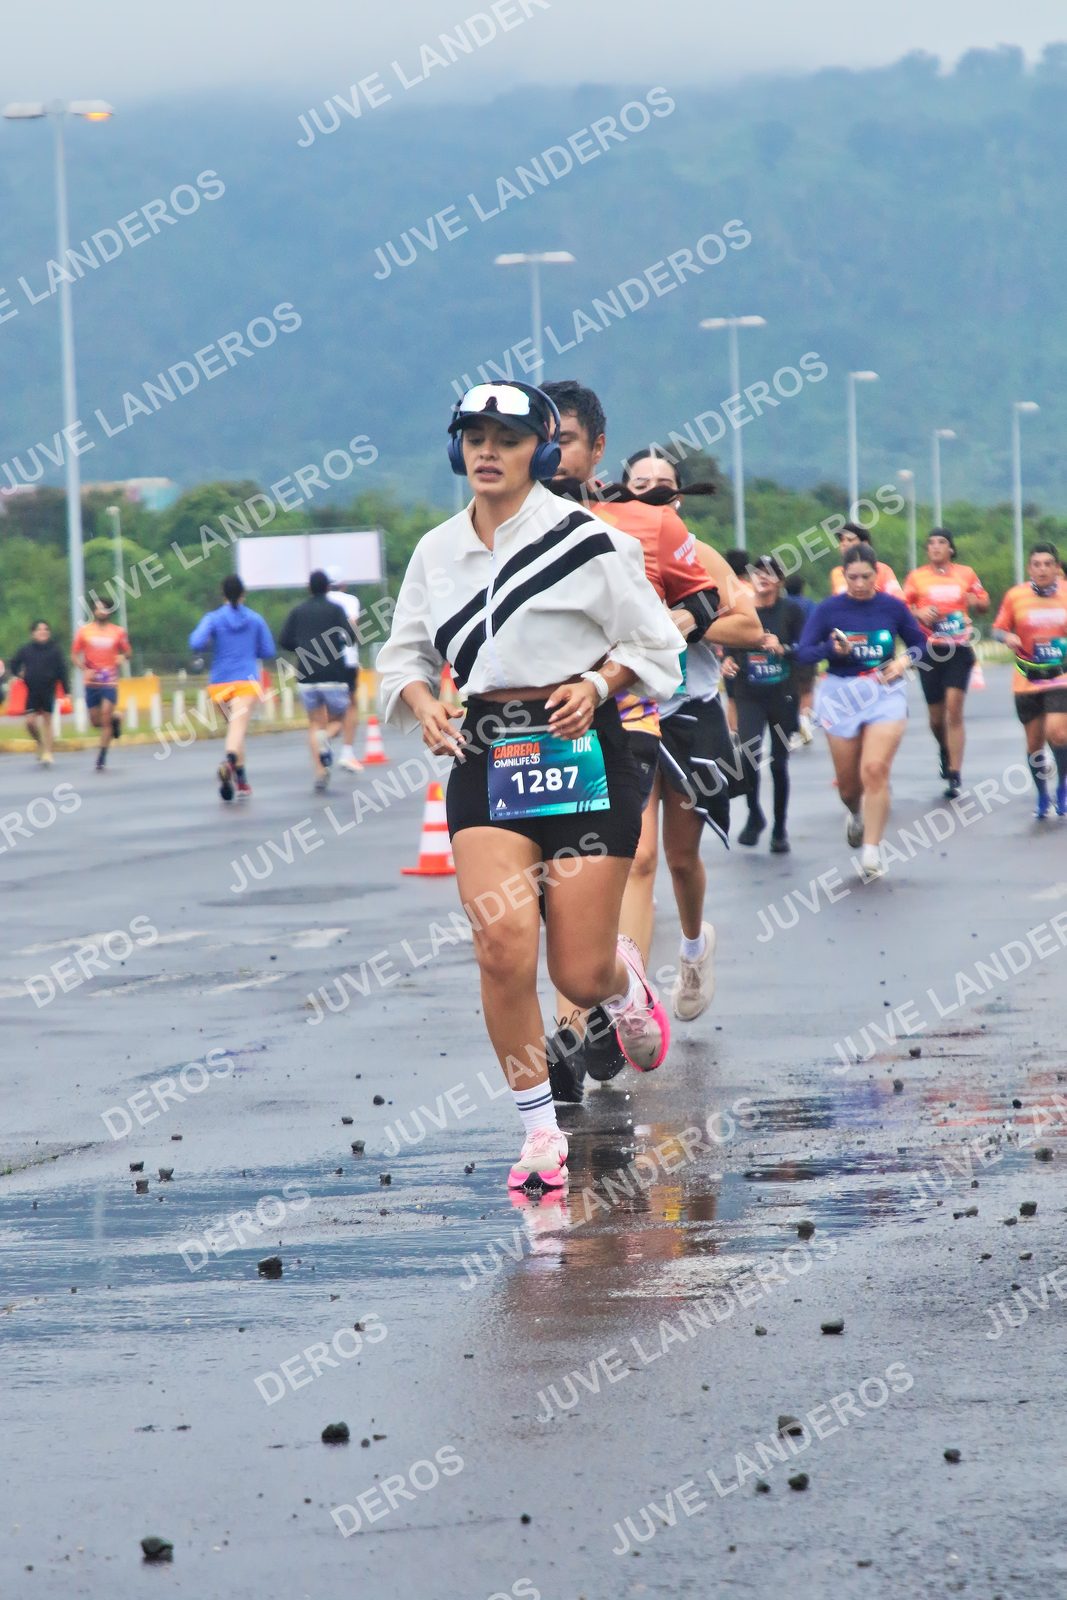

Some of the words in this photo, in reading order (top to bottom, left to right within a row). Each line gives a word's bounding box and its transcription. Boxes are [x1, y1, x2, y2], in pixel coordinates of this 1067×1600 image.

[494, 742, 540, 759] CARRERA
[571, 736, 592, 753] 10K
[493, 757, 531, 768] OMNILIFE
[511, 765, 579, 795] 1287
